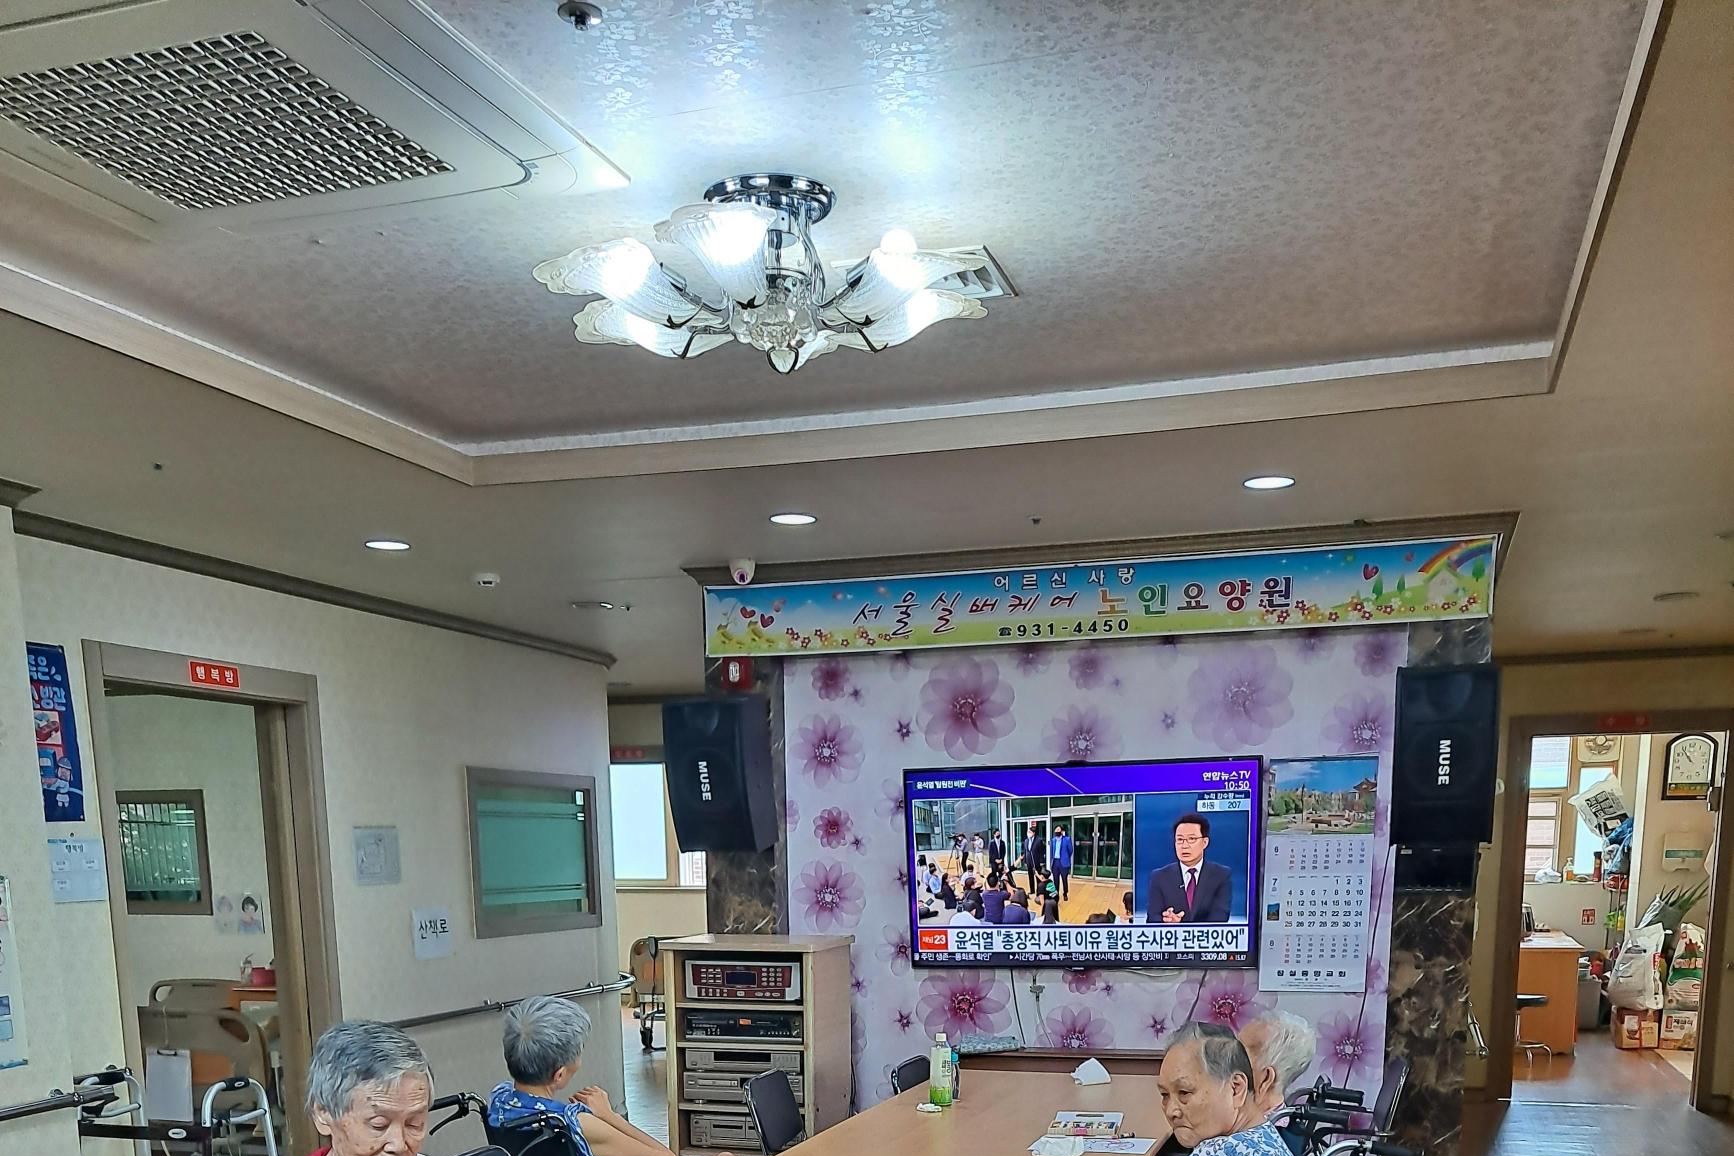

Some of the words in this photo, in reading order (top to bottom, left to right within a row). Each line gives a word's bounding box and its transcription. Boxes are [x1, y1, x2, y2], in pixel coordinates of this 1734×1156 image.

[994, 572, 1067, 592] 어르신
[1088, 567, 1136, 586] 사랑
[853, 590, 1079, 637] 서울실버케어
[1097, 575, 1293, 617] 노인요양원
[1016, 618, 1129, 637] 931-4450
[1437, 739, 1451, 785] MUSE
[698, 761, 712, 801] MUSE
[1202, 770, 1251, 781] 연합뉴스TV
[1224, 781, 1250, 790] 10:50
[1227, 801, 1242, 809] 207
[1272, 878, 1277, 886] 7
[419, 919, 449, 940] 산책로
[955, 930, 994, 950] 윤석열
[996, 930, 1041, 950] "총장직
[1044, 930, 1071, 950] 사퇴
[1075, 929, 1101, 950] 이유
[1105, 929, 1132, 950] 월성
[1136, 929, 1179, 950] 수사와
[1181, 928, 1245, 950] 관련있어"
[1200, 952, 1228, 961] 3309.08
